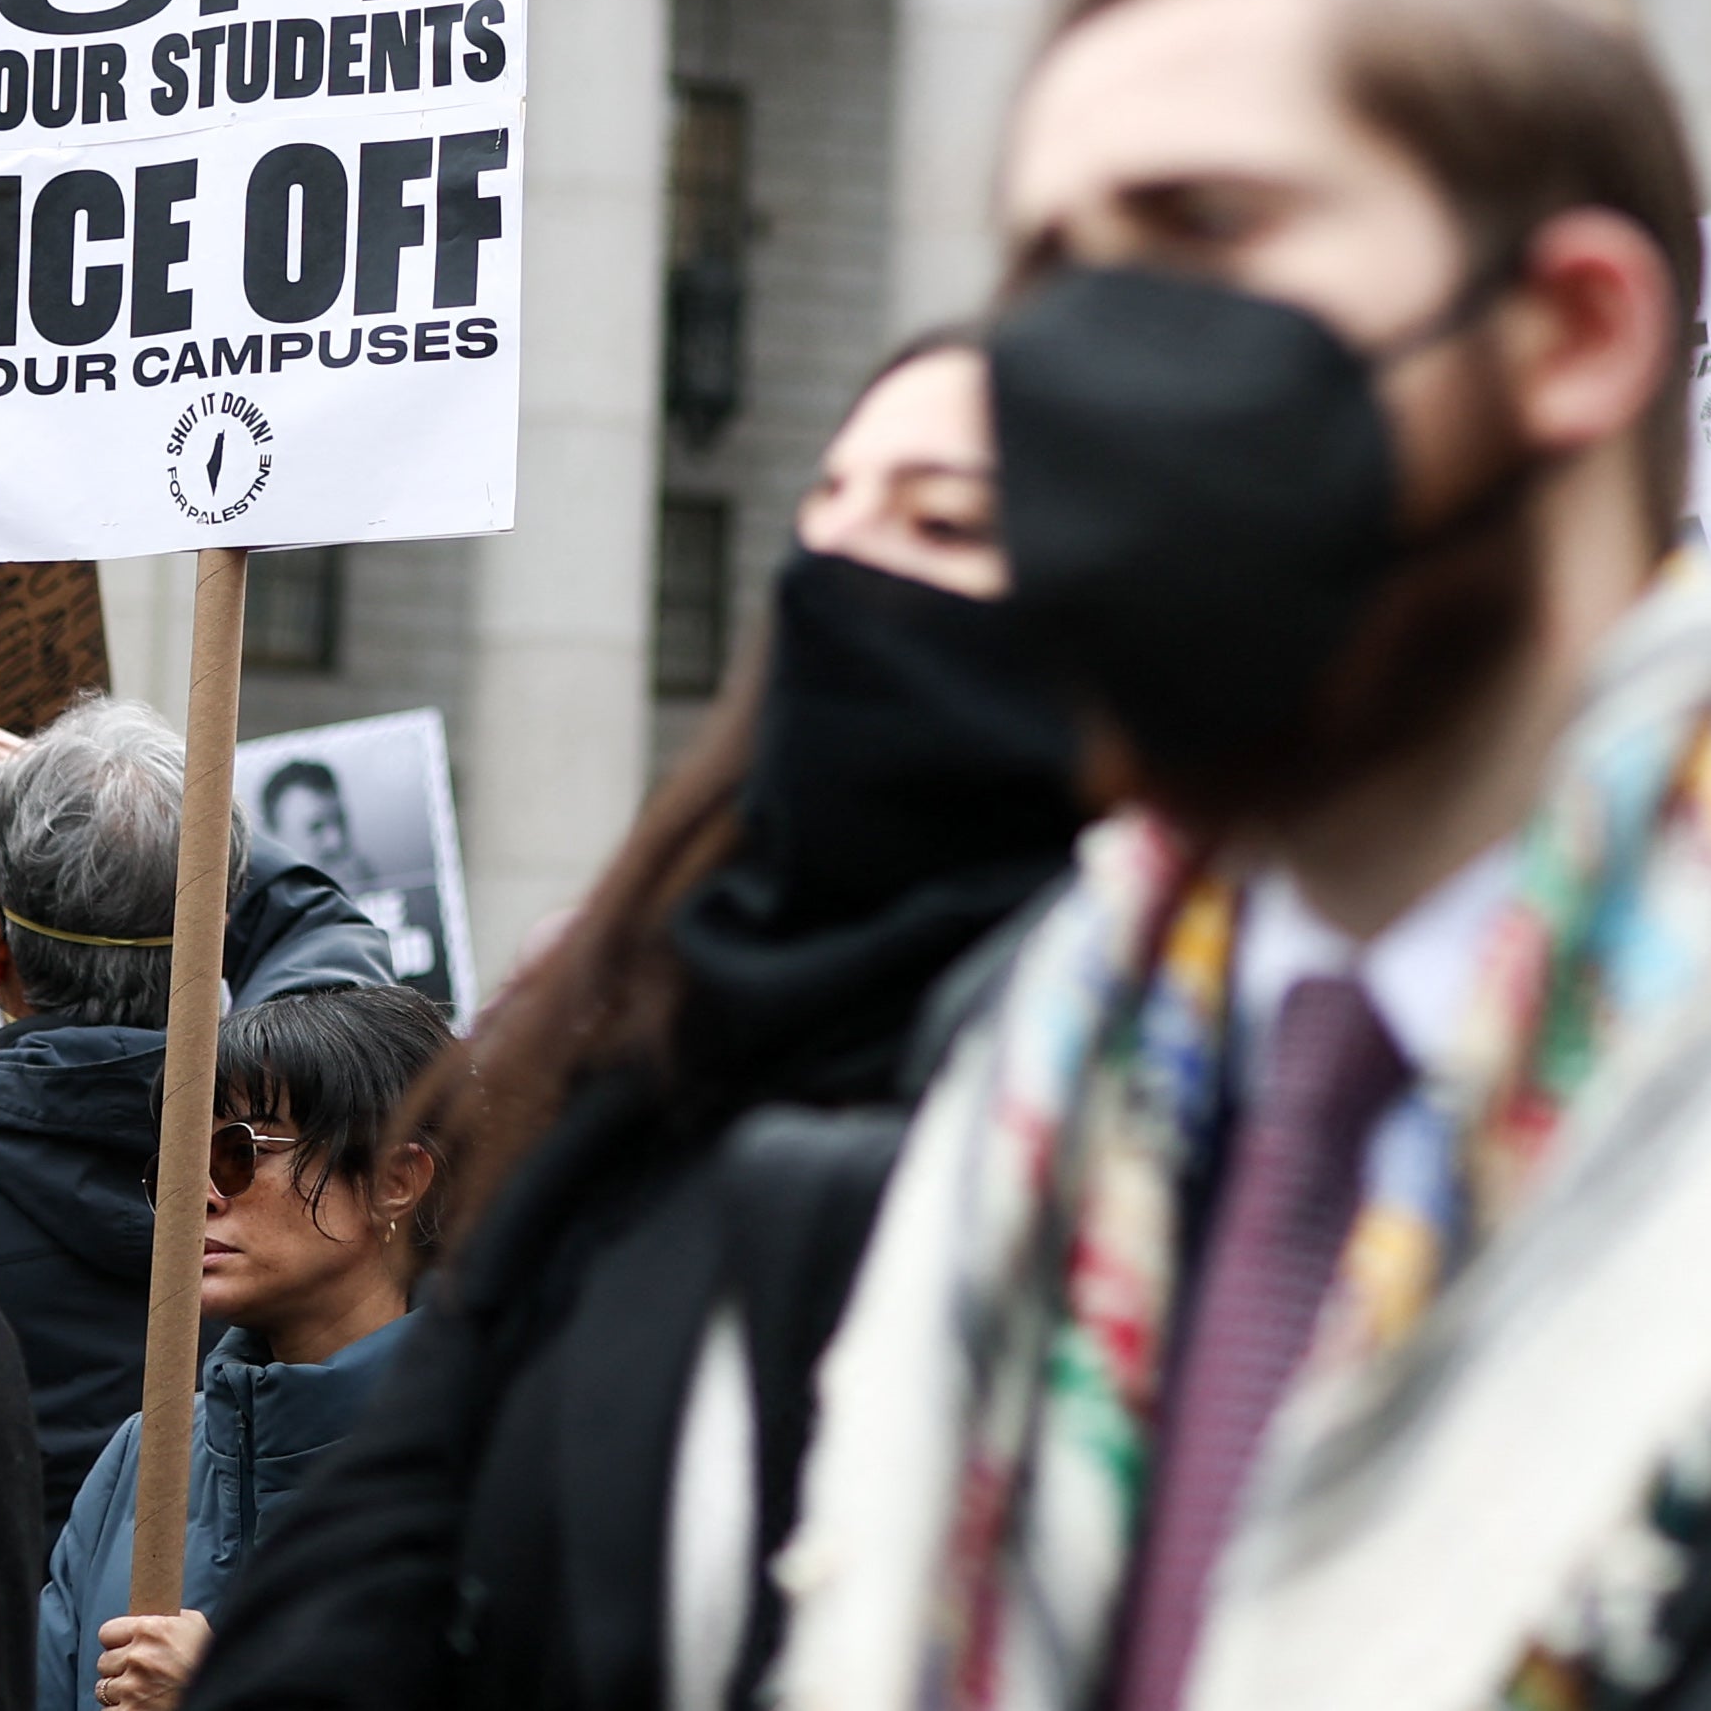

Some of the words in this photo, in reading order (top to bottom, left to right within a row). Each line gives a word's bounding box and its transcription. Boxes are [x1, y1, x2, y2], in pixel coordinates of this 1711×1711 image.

[242, 127, 510, 324] OFF
[132, 317, 499, 388] CAMPUSES
[166, 403, 199, 457] SHUT
[200, 392, 216, 417] IT
[220, 391, 274, 447] DOWN!
[167, 466, 188, 512] FOR
[186, 453, 272, 525] PALESTINE
